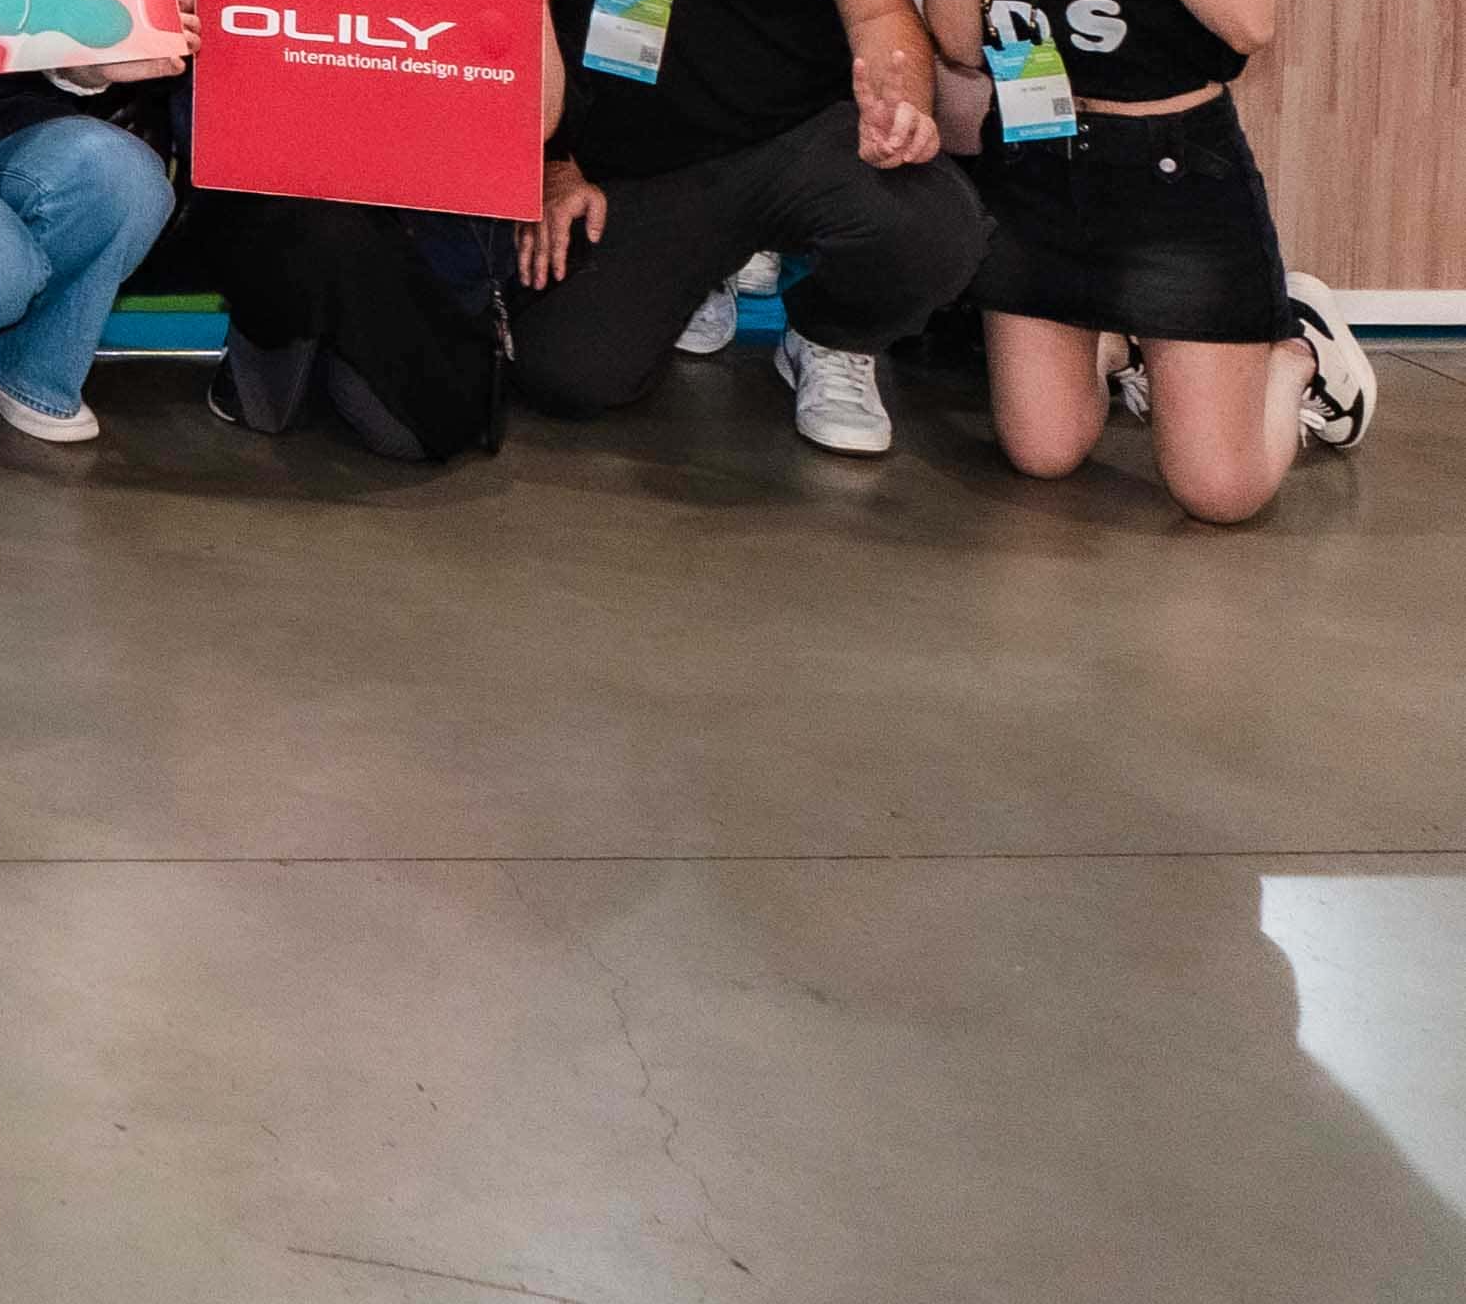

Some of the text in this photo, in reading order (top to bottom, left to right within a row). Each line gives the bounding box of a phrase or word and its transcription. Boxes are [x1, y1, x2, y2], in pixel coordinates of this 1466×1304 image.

[220, 4, 457, 51] OLILY
[283, 47, 515, 84] international design group
